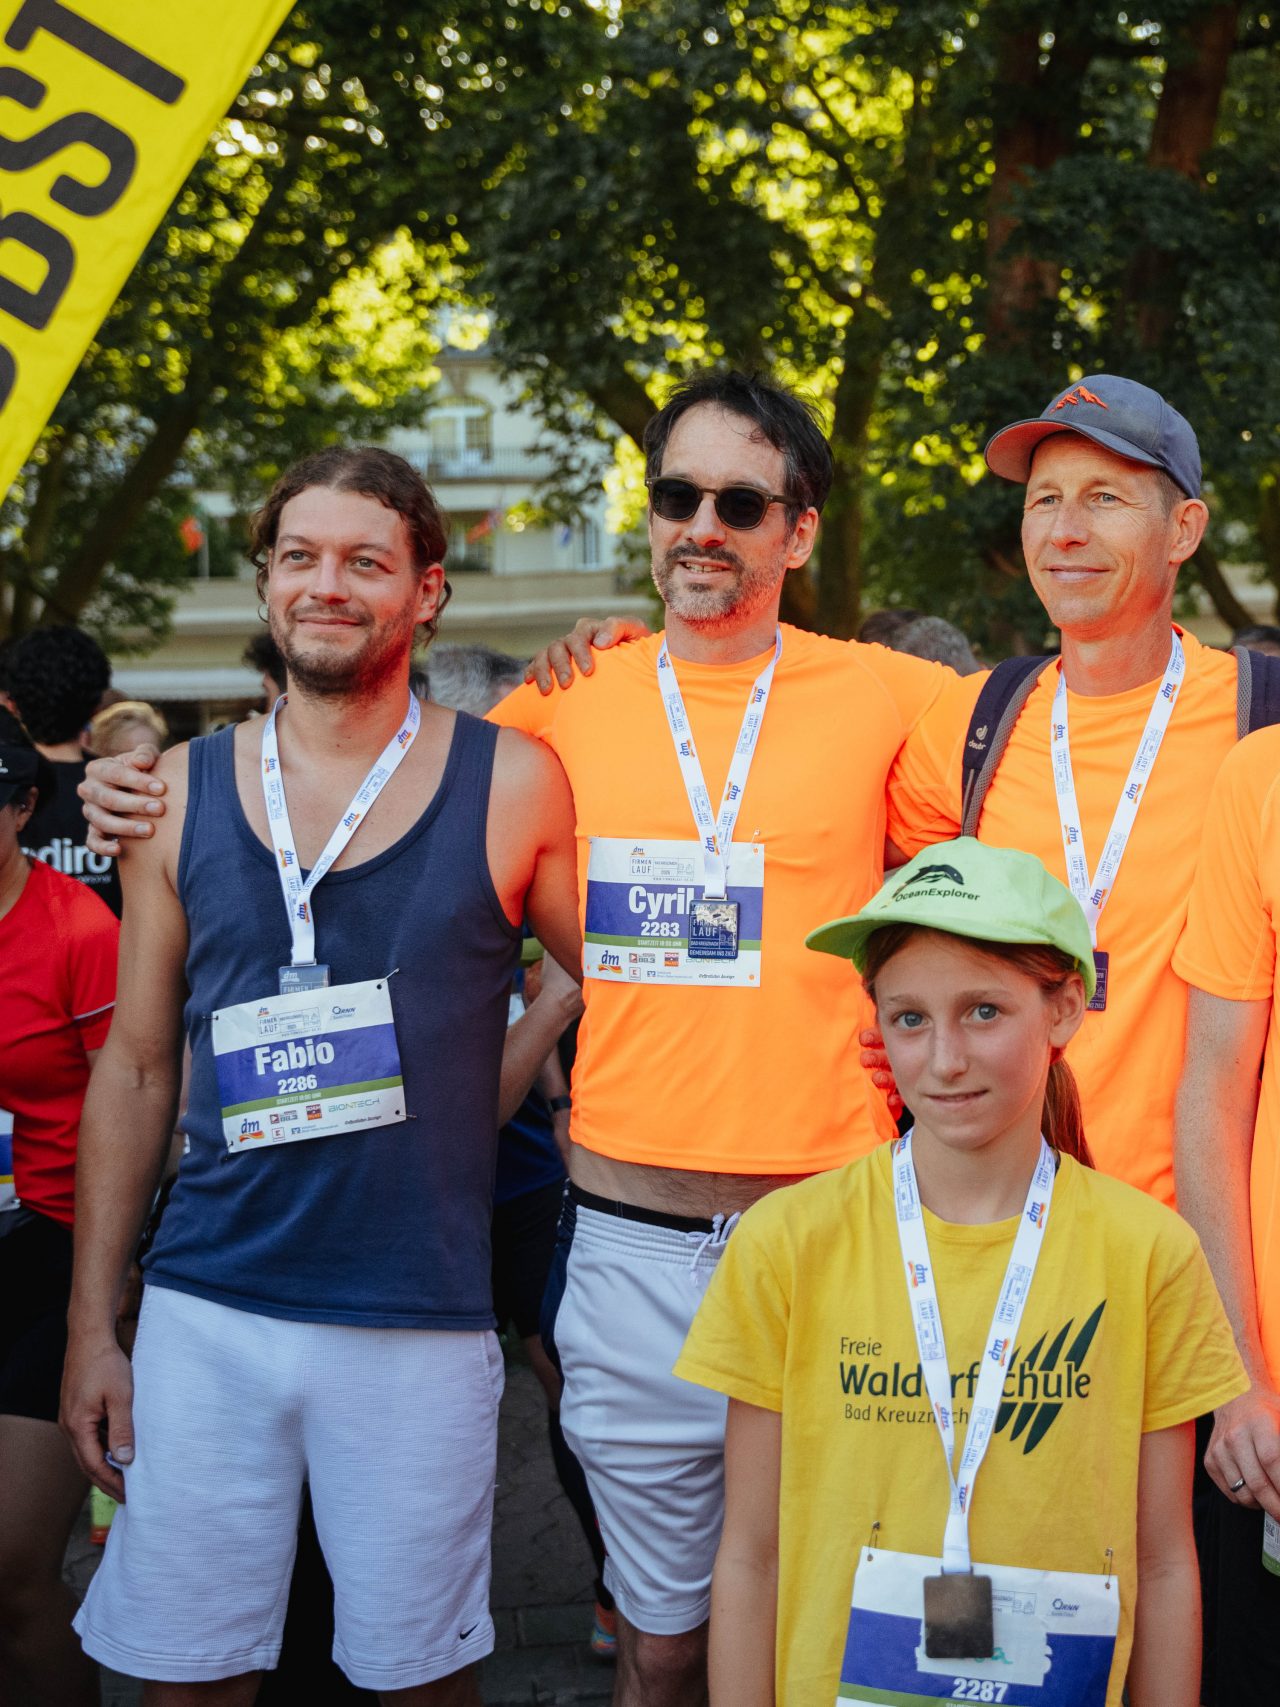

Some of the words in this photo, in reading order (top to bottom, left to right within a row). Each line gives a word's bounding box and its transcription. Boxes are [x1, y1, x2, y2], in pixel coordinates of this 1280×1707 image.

[659, 656, 666, 668] dm
[755, 688, 765, 702] dm
[1162, 683, 1173, 698] dm
[397, 729, 409, 744] dm
[1057, 724, 1065, 739] dm
[680, 742, 689, 756] dm
[731, 785, 741, 800] dm
[1126, 783, 1137, 799] dm
[344, 812, 356, 827] dm
[1069, 827, 1078, 843] dm
[705, 837, 715, 852] dm
[284, 850, 295, 865] dm
[632, 865, 651, 874] LAUF
[629, 885, 695, 919] Cyril
[895, 887, 980, 902] OceanExplorer
[1091, 889, 1103, 905] dm
[296, 902, 306, 919] dm
[641, 922, 680, 937] 2283
[692, 927, 718, 937] LAUF
[601, 951, 619, 966] dm
[284, 971, 298, 981] dm
[260, 1024, 278, 1034] LAUF
[254, 1038, 335, 1076] Fabio
[278, 1074, 318, 1094] 2286
[328, 1098, 381, 1113] BIONTECH
[241, 1119, 260, 1134] dm
[1026, 1202, 1041, 1222] dm
[916, 1264, 928, 1283] dm
[840, 1336, 882, 1356] Freie
[991, 1339, 1004, 1361] dm
[840, 1361, 1091, 1400] Waldrfchule
[845, 1403, 870, 1420] Bad
[877, 1406, 968, 1424] Kreuznch
[952, 1678, 1009, 1703] 2287
